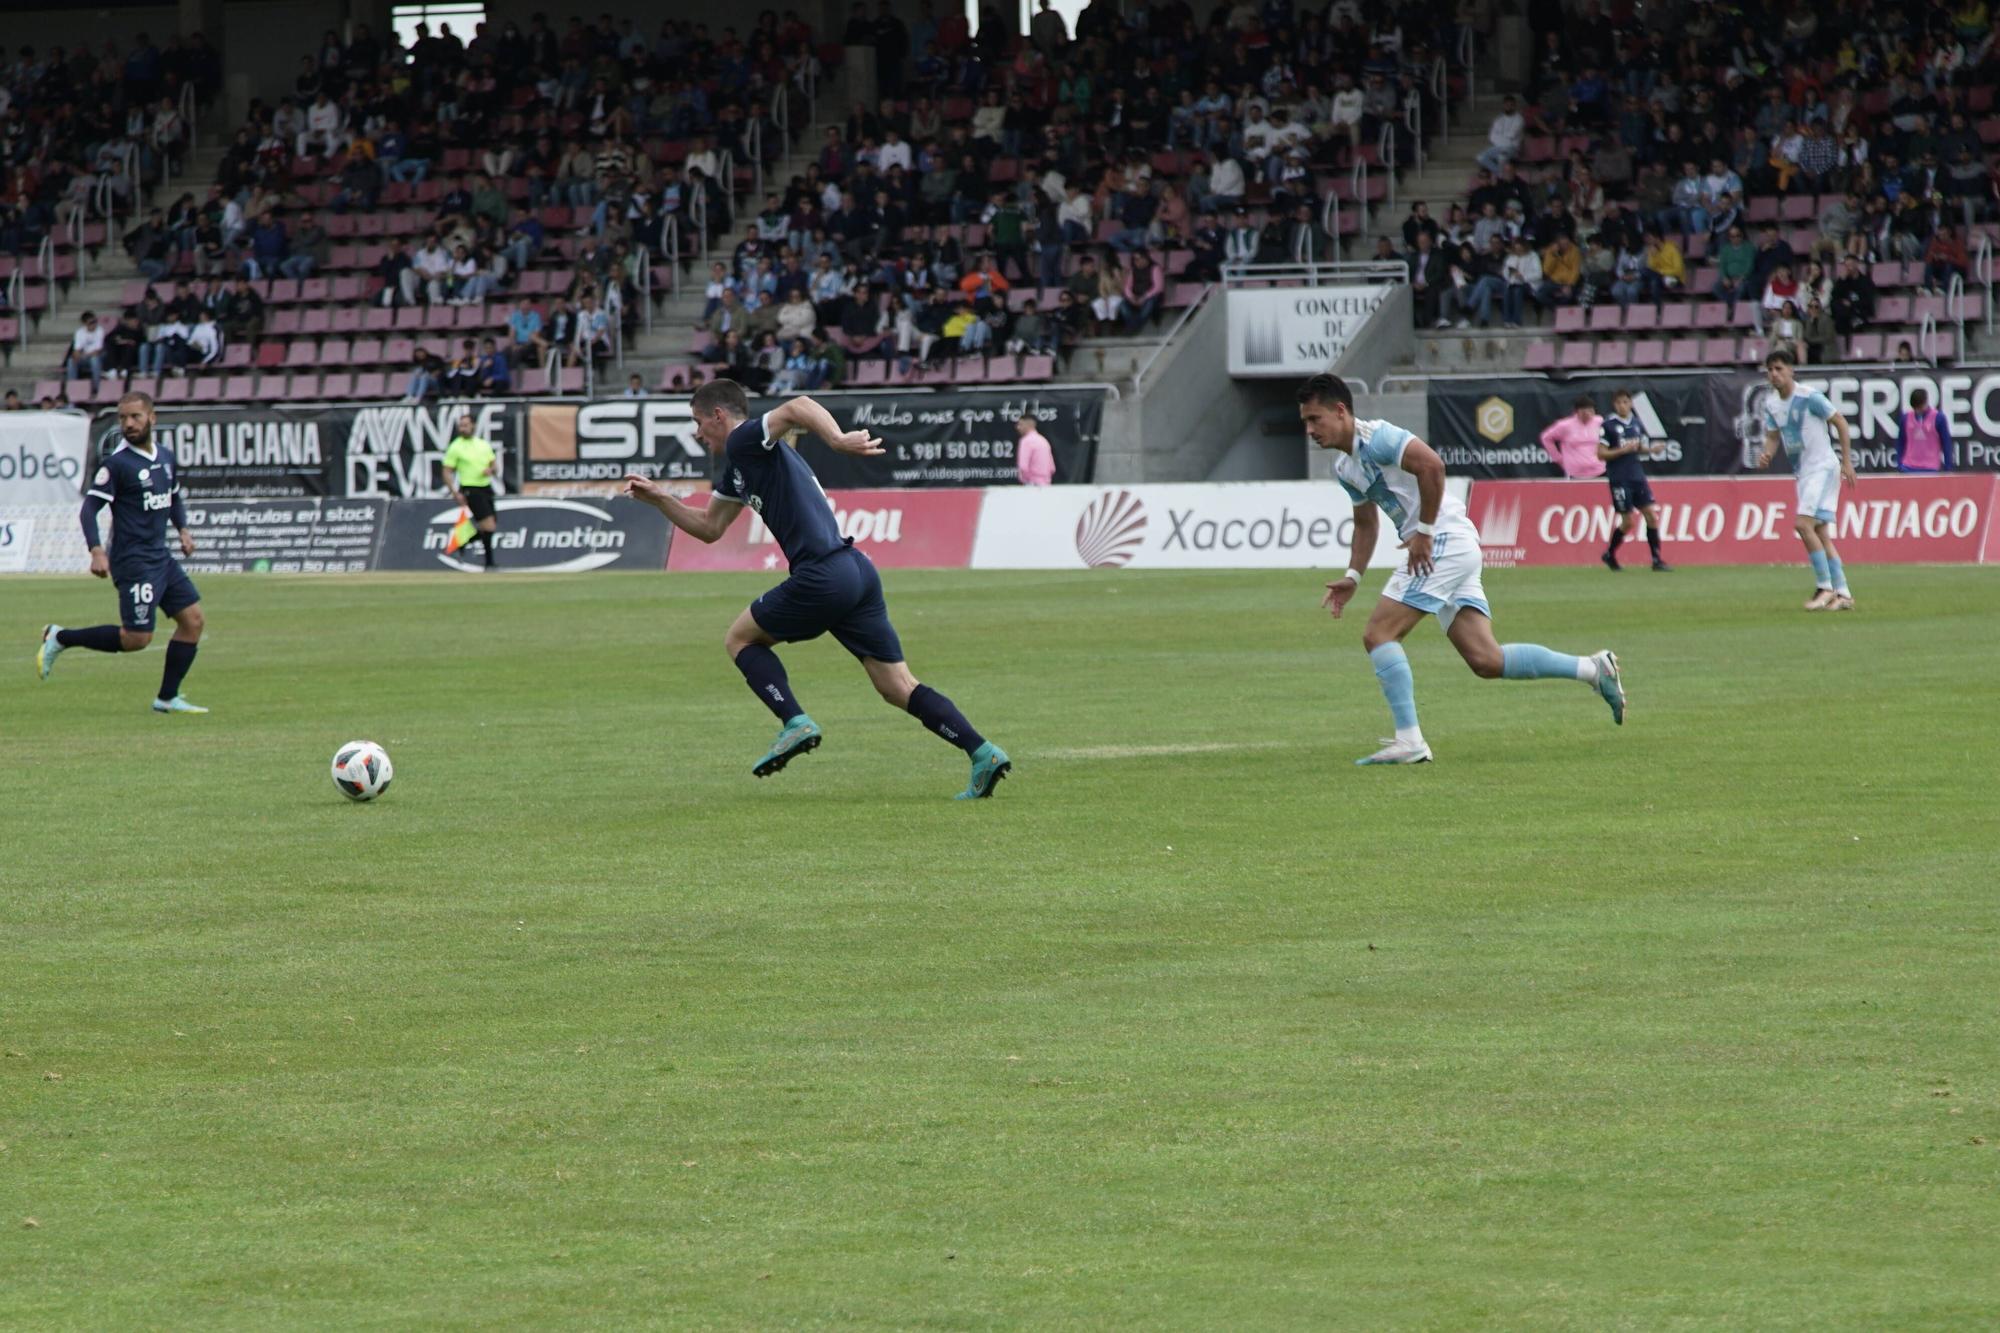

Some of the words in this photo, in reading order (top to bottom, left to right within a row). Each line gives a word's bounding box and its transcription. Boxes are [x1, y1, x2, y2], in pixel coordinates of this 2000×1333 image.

[1325, 320, 1348, 338] DE
[853, 398, 913, 425] Mucho
[959, 408, 994, 434] que
[175, 422, 322, 467] GALICIANA
[914, 442, 941, 460] 981
[946, 441, 967, 459] 50
[968, 440, 990, 459] 02
[992, 440, 1013, 459] 02
[1437, 445, 1553, 465] fútbolemotio
[531, 464, 622, 480] SEGUNDO
[325, 505, 376, 522] stock
[1735, 502, 1787, 541] DE
[1795, 498, 1979, 540] NTIAGO
[423, 527, 527, 555] inral
[533, 526, 625, 548] motion
[129, 582, 154, 604] 16
